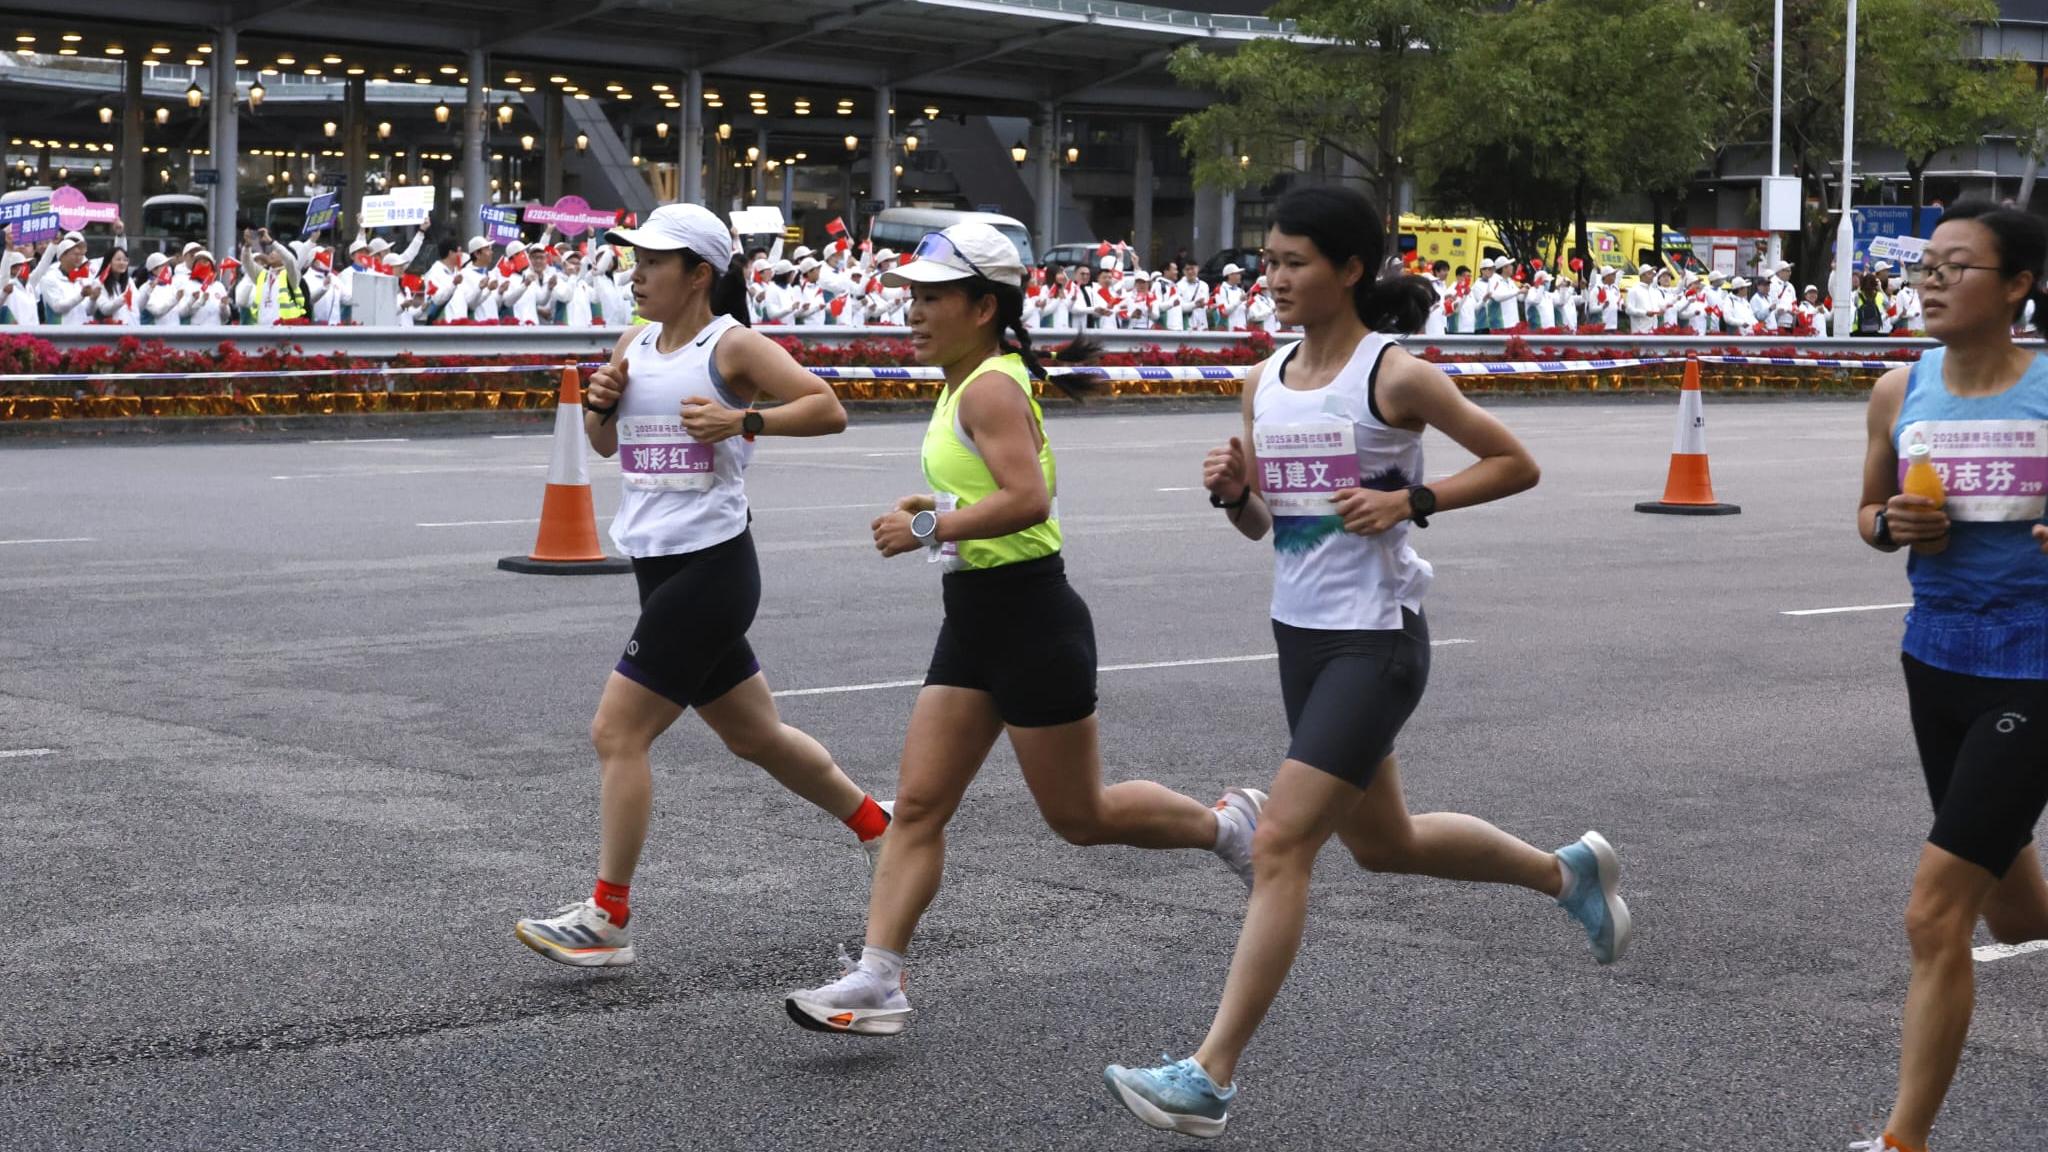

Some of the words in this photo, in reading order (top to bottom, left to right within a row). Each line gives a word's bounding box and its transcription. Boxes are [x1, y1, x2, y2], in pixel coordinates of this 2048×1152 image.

[1867, 208, 1909, 219] Shenzhen
[632, 447, 690, 470] 刘彩红
[1264, 460, 1332, 489] 肖建文
[2019, 481, 2043, 492] 219
